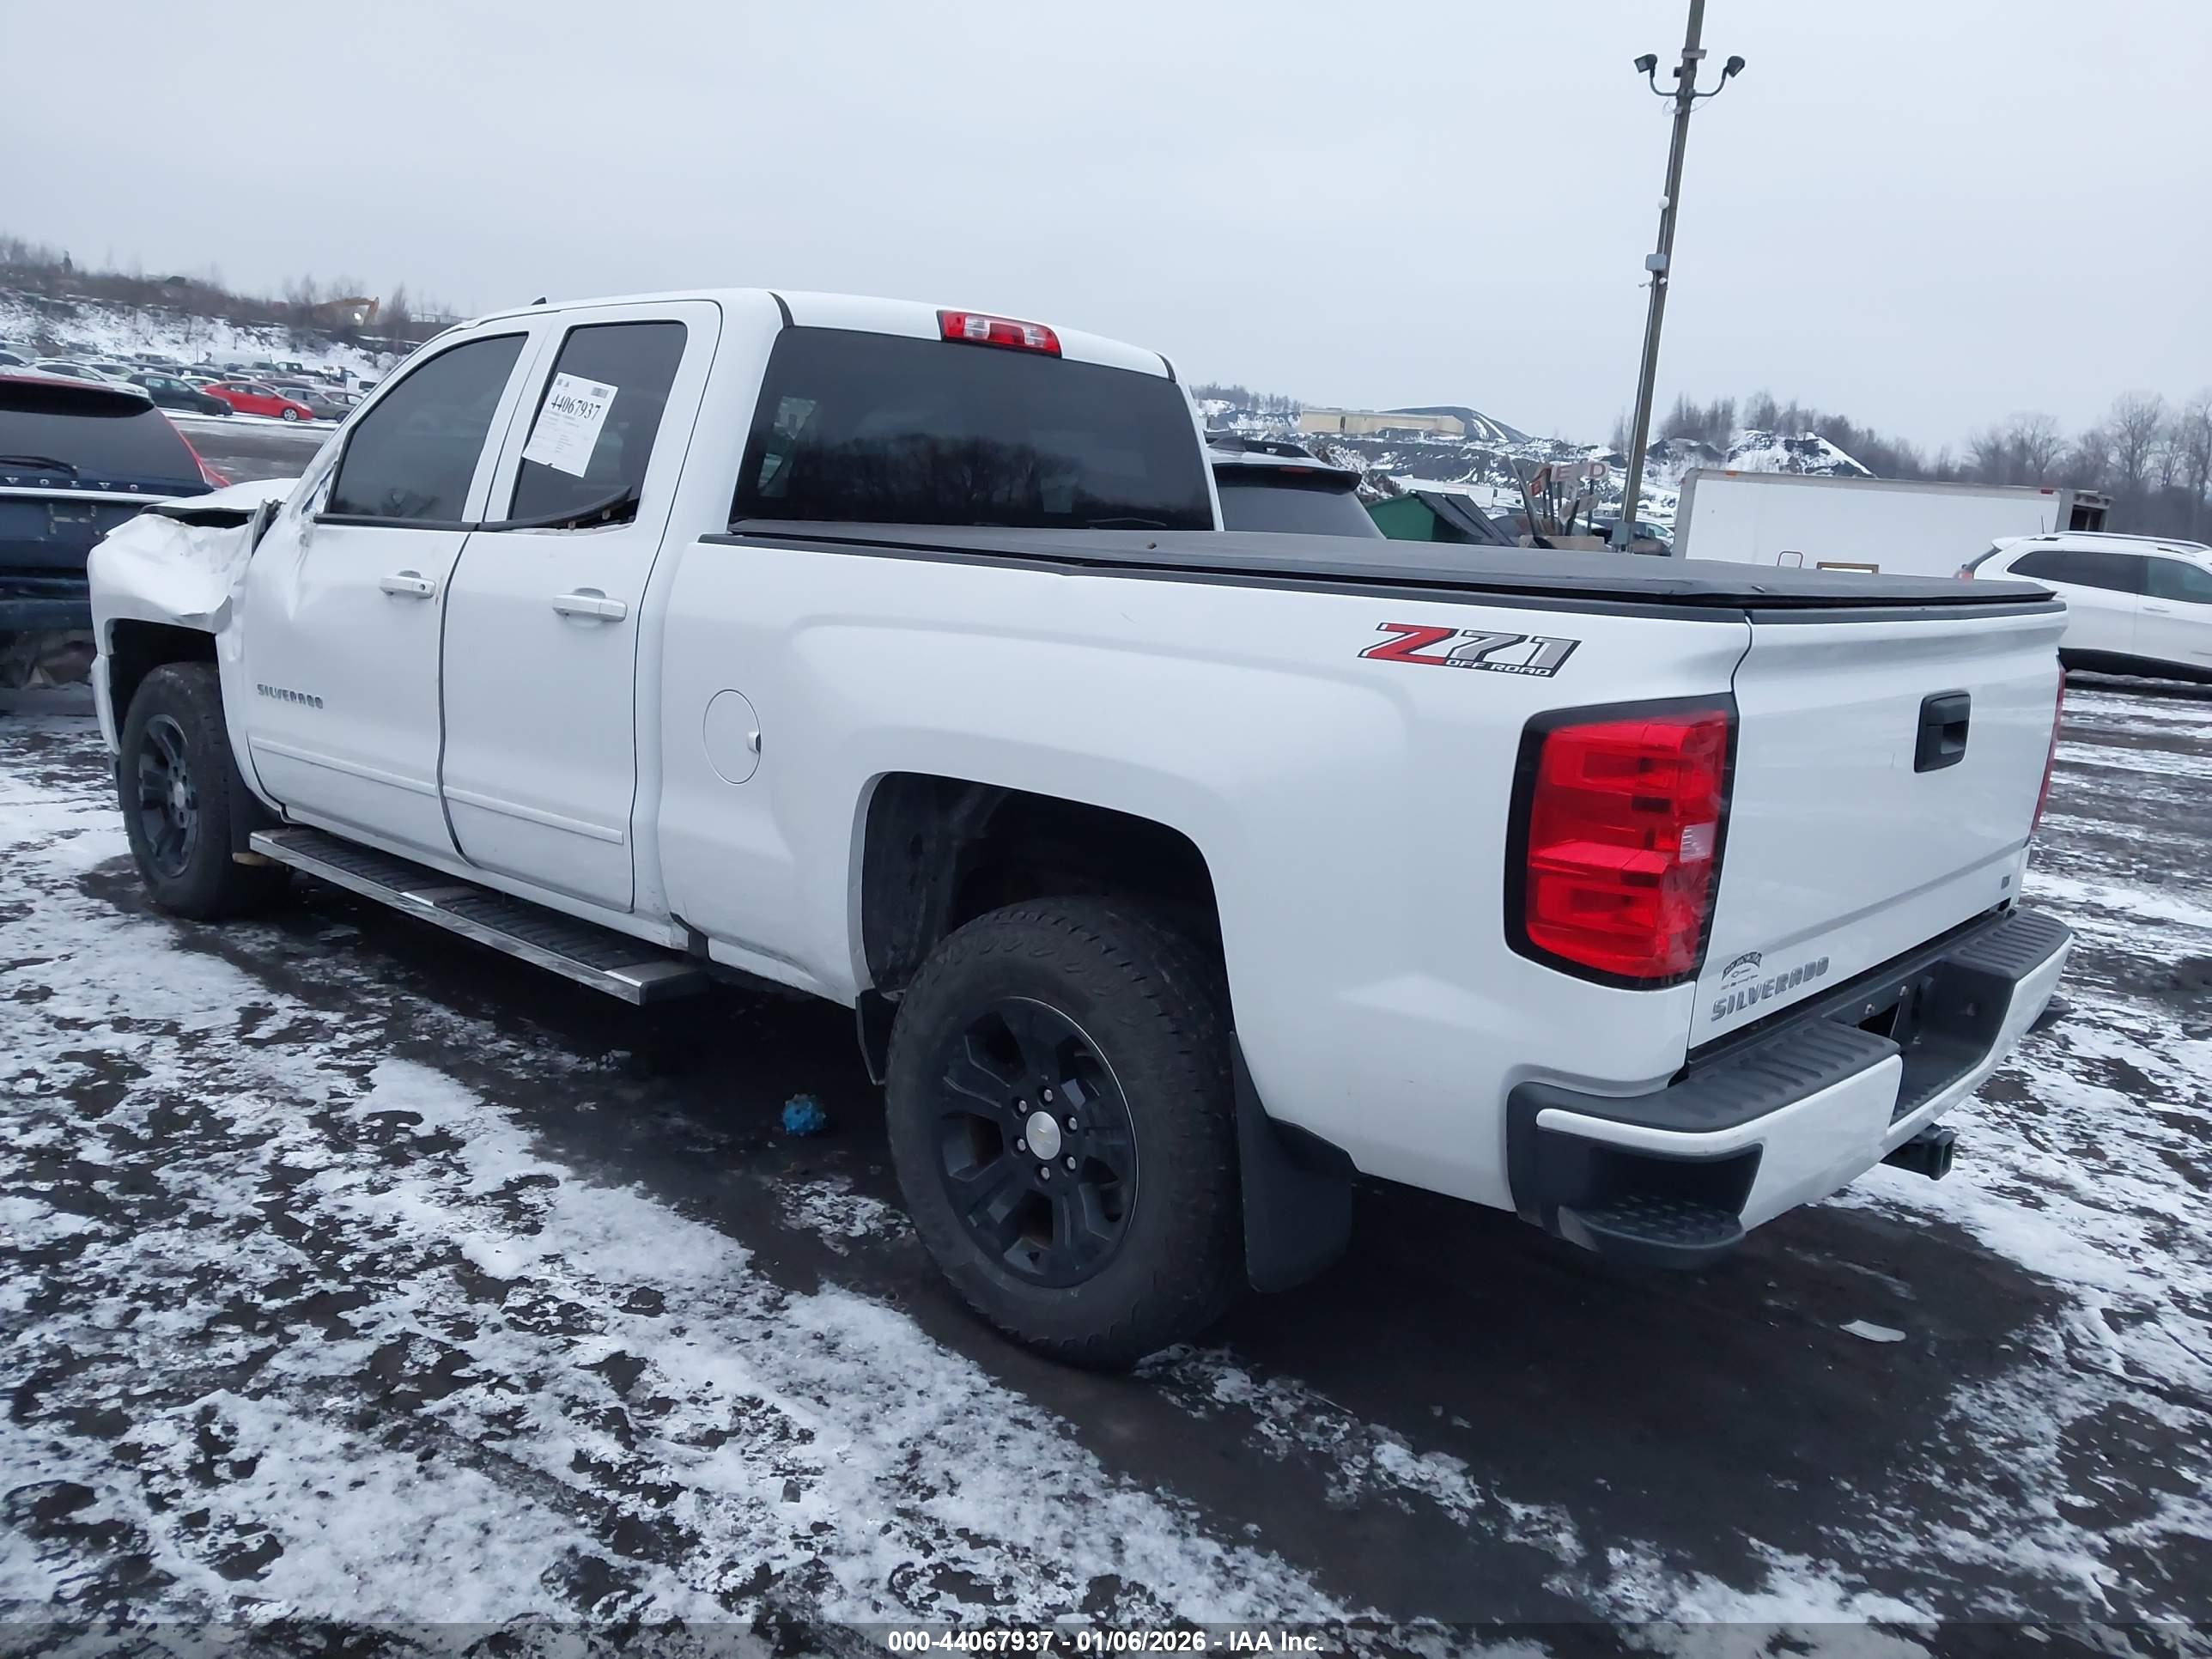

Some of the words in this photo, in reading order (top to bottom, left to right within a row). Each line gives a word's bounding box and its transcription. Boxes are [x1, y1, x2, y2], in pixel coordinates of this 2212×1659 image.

[550, 394, 601, 421] 44067937
[4, 477, 138, 491] VOLVO
[1357, 622, 1582, 678] Z71
[1445, 659, 1487, 668] OFF
[1490, 663, 1553, 677] ROAD
[257, 684, 324, 709] SILVERADO
[1711, 956, 1830, 1022] SILVERADO
